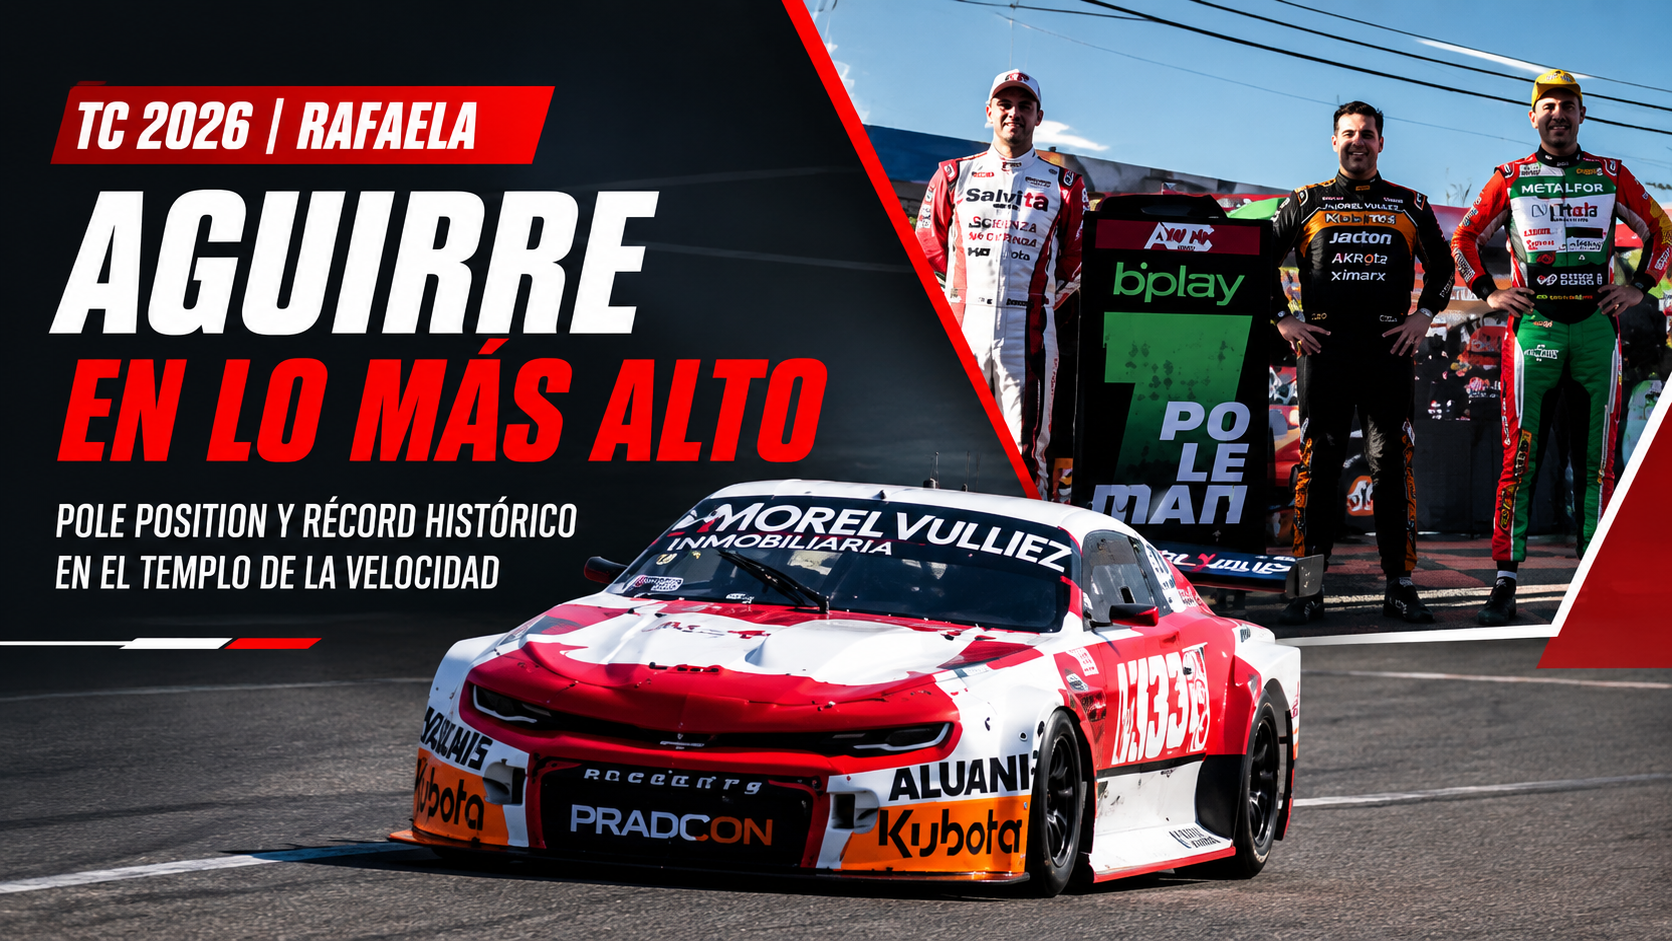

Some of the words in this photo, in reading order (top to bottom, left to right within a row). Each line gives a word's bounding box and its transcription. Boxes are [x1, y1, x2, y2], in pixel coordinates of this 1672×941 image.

[966, 188, 1049, 212] Salvita
[1521, 183, 1604, 194] METALFOR
[1331, 269, 1386, 281] ximarx
[1159, 401, 1251, 441] PO
[1176, 443, 1250, 482] LE
[667, 533, 892, 556] INMOBILIARIA
[897, 511, 1072, 573] VULLIEZ
[889, 754, 1029, 802] ALUANI
[570, 804, 773, 846] PRADCON
[877, 809, 1023, 858] Kubota
